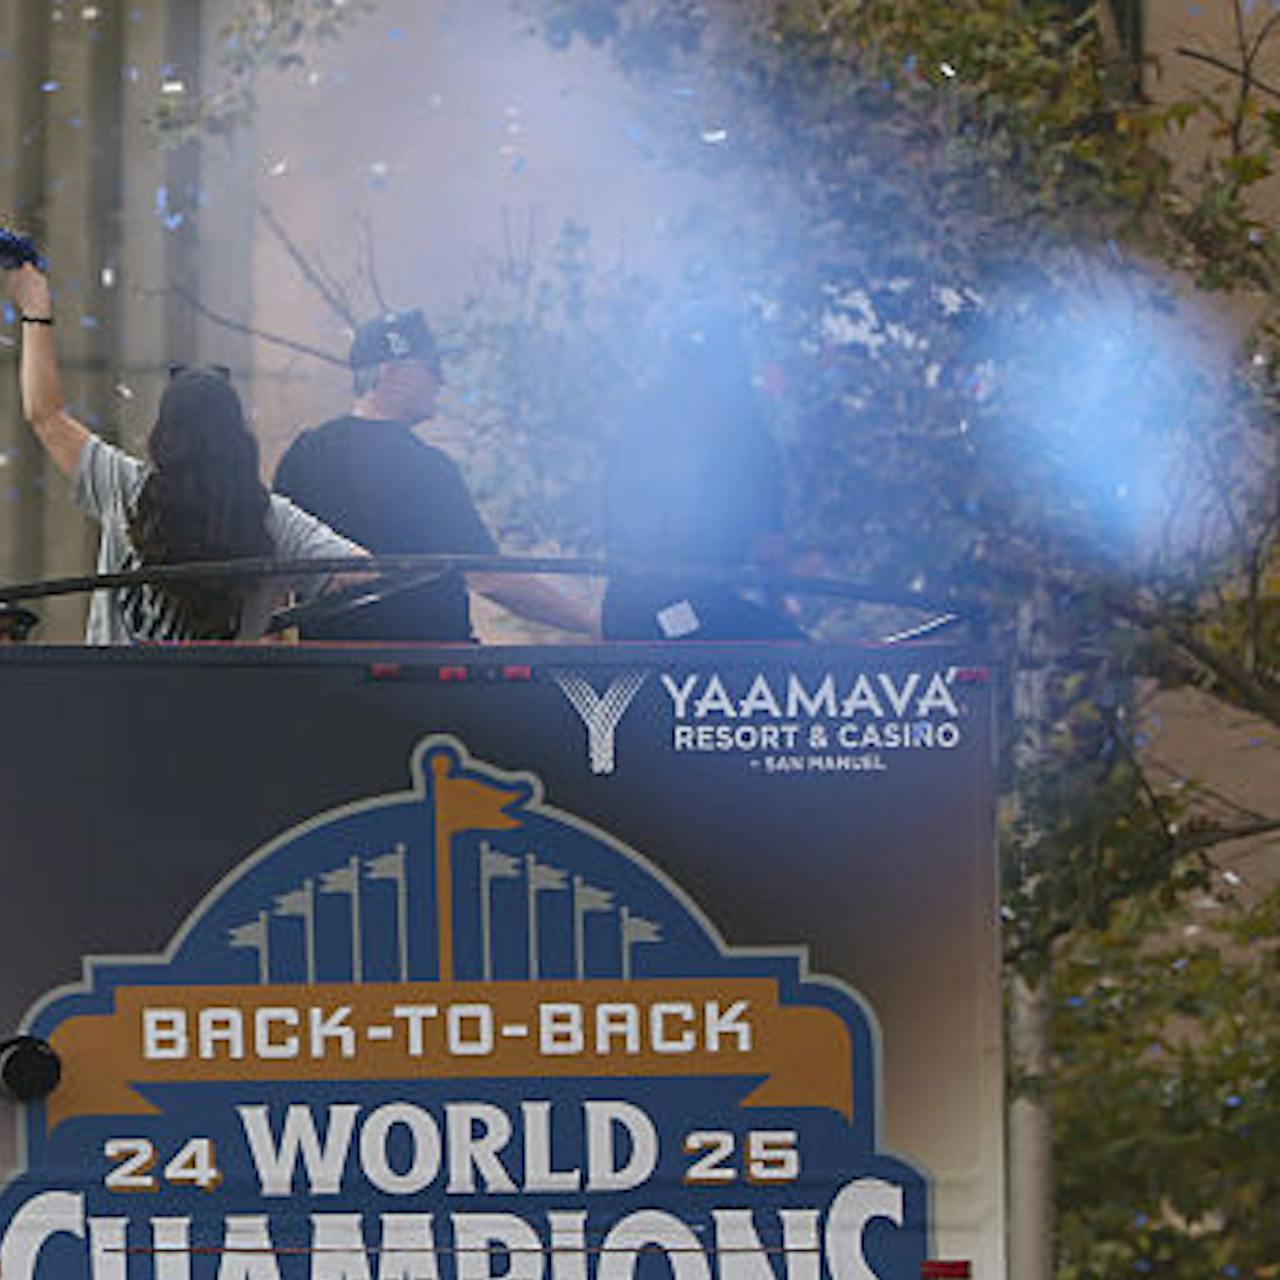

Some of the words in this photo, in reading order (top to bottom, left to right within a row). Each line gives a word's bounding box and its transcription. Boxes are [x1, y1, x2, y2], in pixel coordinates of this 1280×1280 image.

[674, 725, 798, 752] RESORT
[808, 724, 828, 750] &
[840, 721, 960, 749] CASINO
[141, 1000, 752, 1061] BACK-TO-BACK
[103, 1137, 221, 1191] 24
[236, 1100, 659, 1197] WORLD
[683, 1129, 801, 1183] 25
